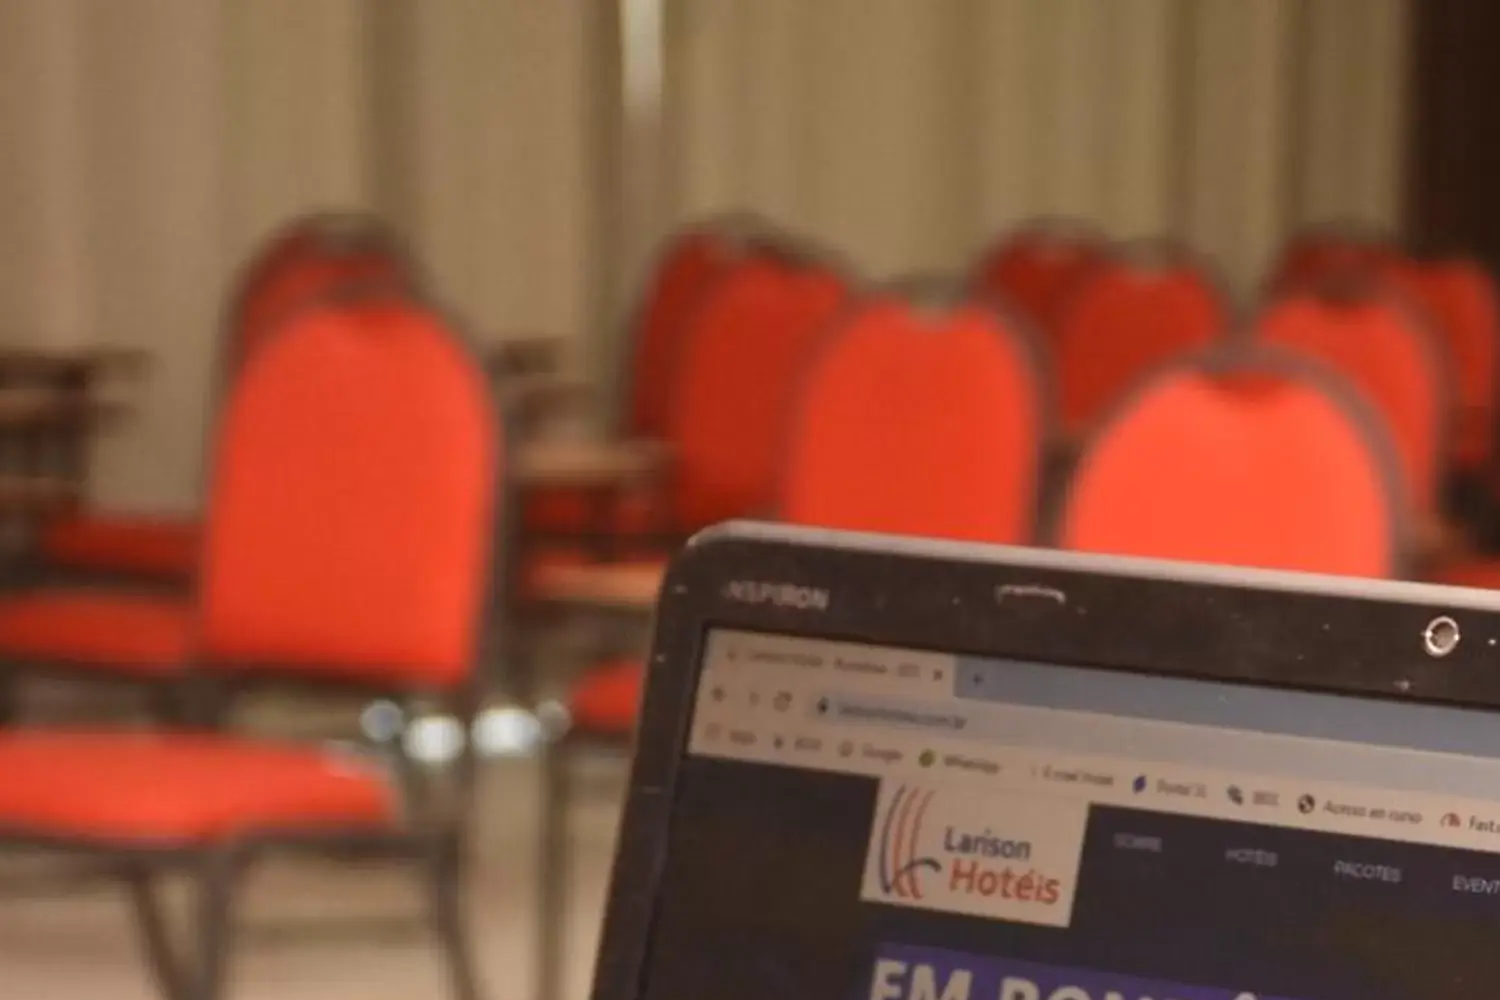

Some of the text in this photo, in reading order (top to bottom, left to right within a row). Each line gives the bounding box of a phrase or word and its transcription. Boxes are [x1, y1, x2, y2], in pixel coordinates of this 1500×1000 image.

[943, 826, 1032, 860] Larison
[949, 857, 1062, 905] Hotéis
[1333, 860, 1402, 883] PACOTES
